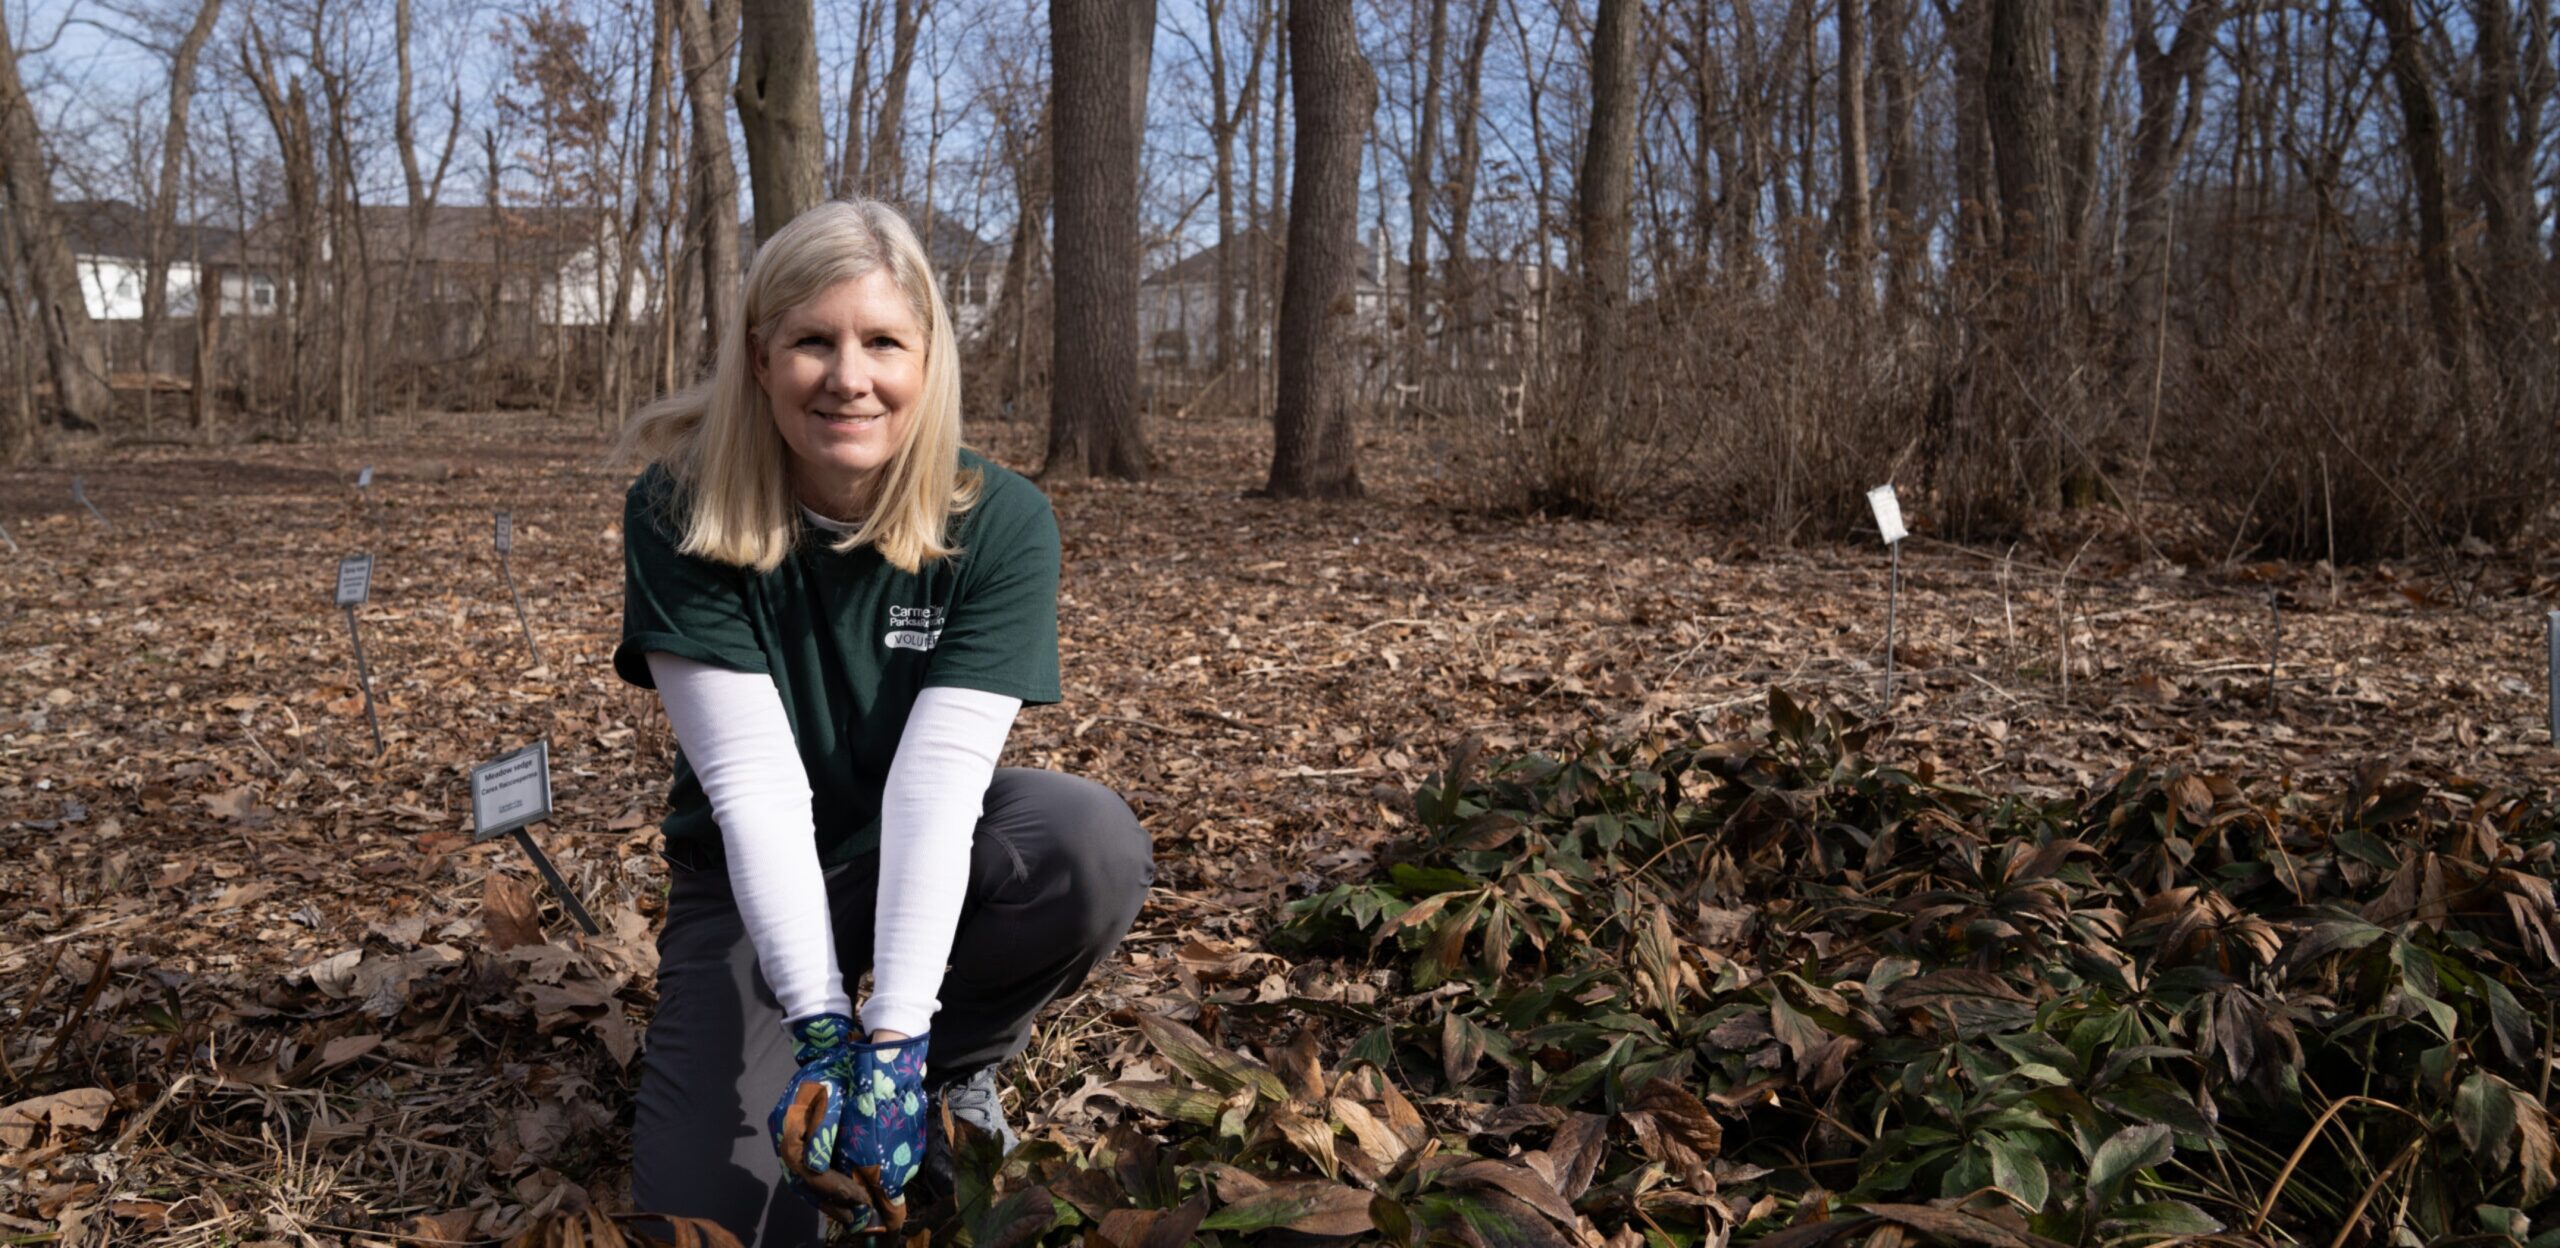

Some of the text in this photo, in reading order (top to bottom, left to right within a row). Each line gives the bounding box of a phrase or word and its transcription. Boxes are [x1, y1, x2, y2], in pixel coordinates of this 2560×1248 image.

[484, 760, 532, 781] Meadow sedge
[481, 785, 498, 796] Carex
